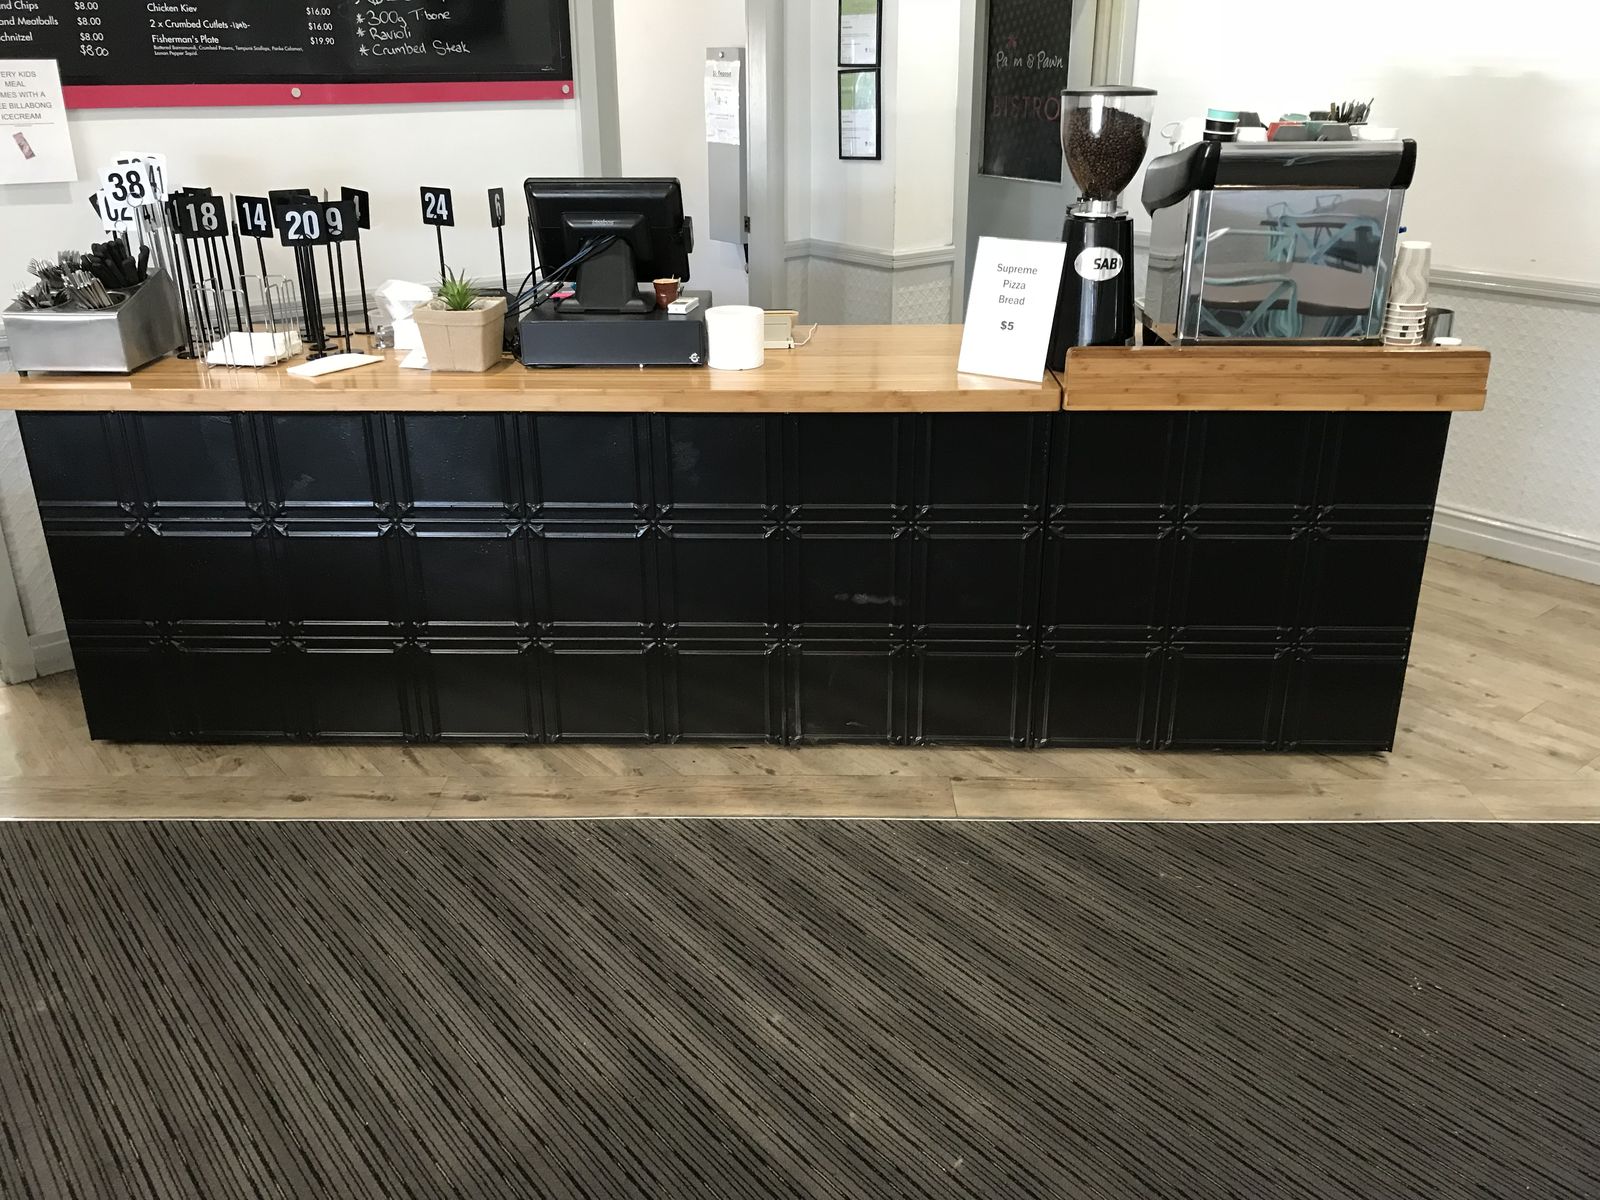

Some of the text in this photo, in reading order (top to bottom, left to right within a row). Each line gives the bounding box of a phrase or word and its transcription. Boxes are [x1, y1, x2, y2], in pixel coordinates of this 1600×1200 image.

[14, 0, 39, 12] Chips
[74, 1, 99, 11] $8.00
[146, 2, 198, 13] Chicken Kiev
[306, 6, 331, 16] $16.00
[17, 15, 59, 26] Meatballs
[76, 16, 102, 26] $8.00
[149, 19, 156, 28] 2
[164, 18, 201, 29] Crumbed
[202, 19, 229, 29] Cutlets
[366, 9, 407, 28] 300g
[308, 22, 333, 31] $16.00
[0, 31, 34, 42] chnitzel
[79, 32, 104, 42] $8.00
[151, 34, 219, 44] Fisherman's Plate
[369, 26, 412, 41] Ravioli
[310, 36, 335, 46] $19.90
[372, 39, 471, 56] Crumbed Steak
[1037, 50, 1063, 70] Pawn
[5, 80, 26, 88] MEAL
[9, 101, 53, 109] BILLABONG
[992, 95, 1060, 121] BISTRO
[1, 112, 42, 120] ICECREAM
[107, 169, 146, 202] 38
[424, 192, 448, 220] 24
[494, 193, 502, 220] 6
[185, 202, 219, 232] 18
[242, 202, 267, 232] 14
[325, 206, 343, 236] 9
[285, 210, 320, 240] 20
[996, 262, 1038, 276] Supreme
[1093, 257, 1118, 270] SAB
[1002, 279, 1026, 290] Pizza
[998, 294, 1026, 306] Bread
[1000, 320, 1014, 331] $5
